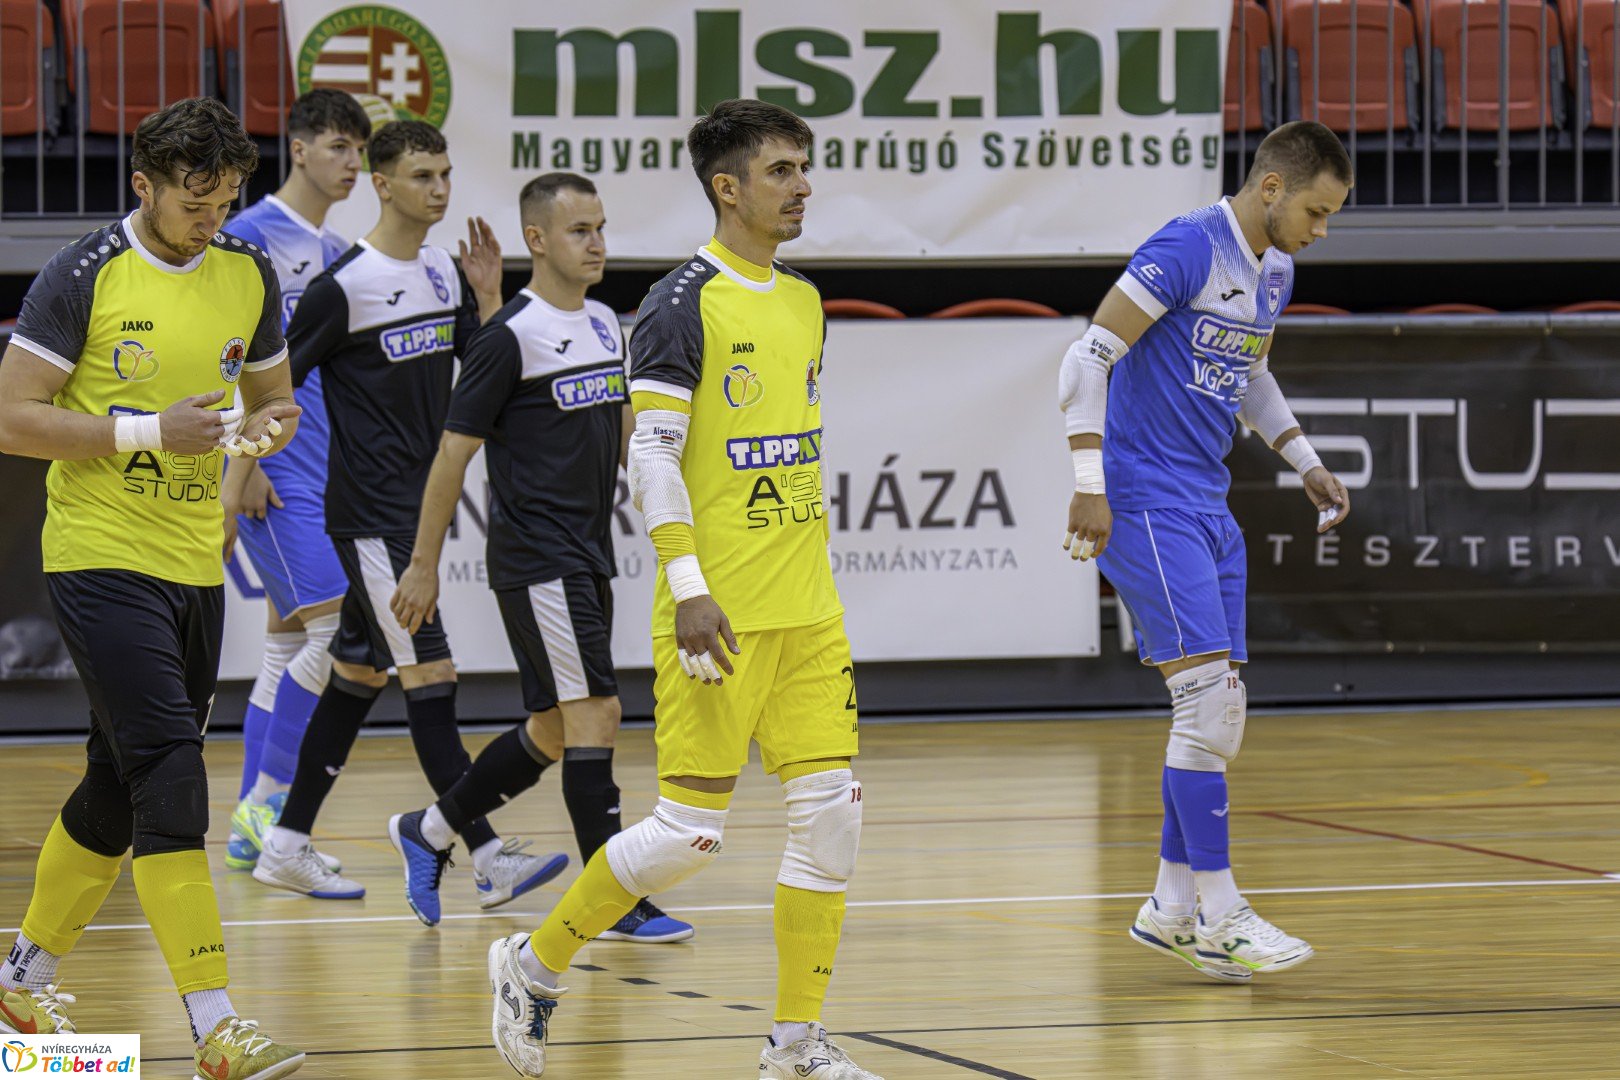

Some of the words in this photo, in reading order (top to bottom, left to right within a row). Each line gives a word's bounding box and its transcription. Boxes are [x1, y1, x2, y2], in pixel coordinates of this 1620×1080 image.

[513, 10, 1221, 118] mlsz.hu
[513, 131, 685, 172] Magyar
[807, 130, 958, 174] arúgó
[983, 127, 1220, 170] Szövetség
[120, 320, 154, 332] JAKO
[732, 342, 755, 354] JAKO
[1193, 359, 1235, 391] VGP
[123, 476, 218, 502] STUDIO
[747, 501, 822, 529] STUD
[831, 546, 1019, 574] ORMÁNYZATA
[190, 943, 225, 957] JAKO
